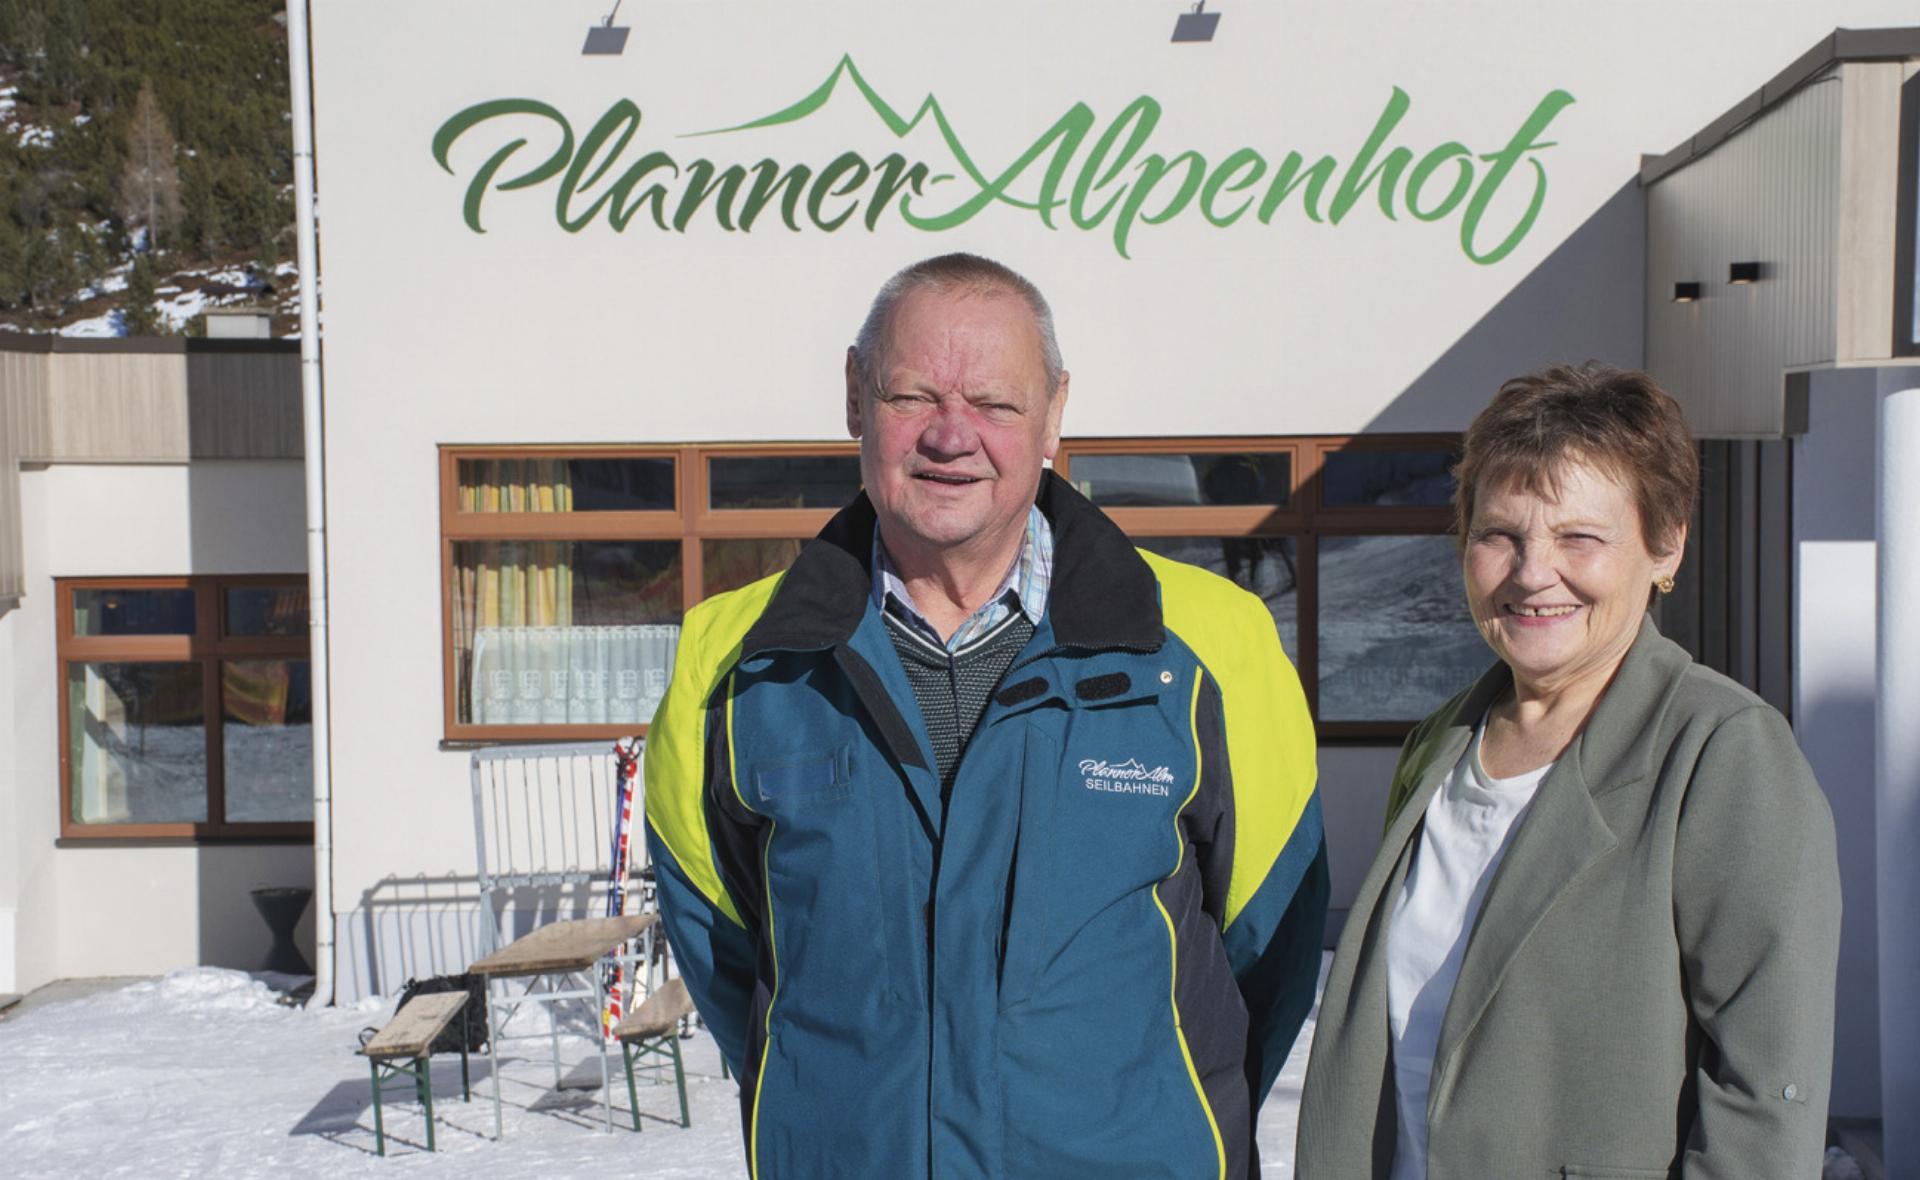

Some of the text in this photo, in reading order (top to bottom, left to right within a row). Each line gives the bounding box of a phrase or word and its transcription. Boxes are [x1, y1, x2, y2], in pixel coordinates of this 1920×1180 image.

[432, 86, 1575, 265] Planner Alpenhof
[1085, 778, 1168, 797] SEILBAHNEN
